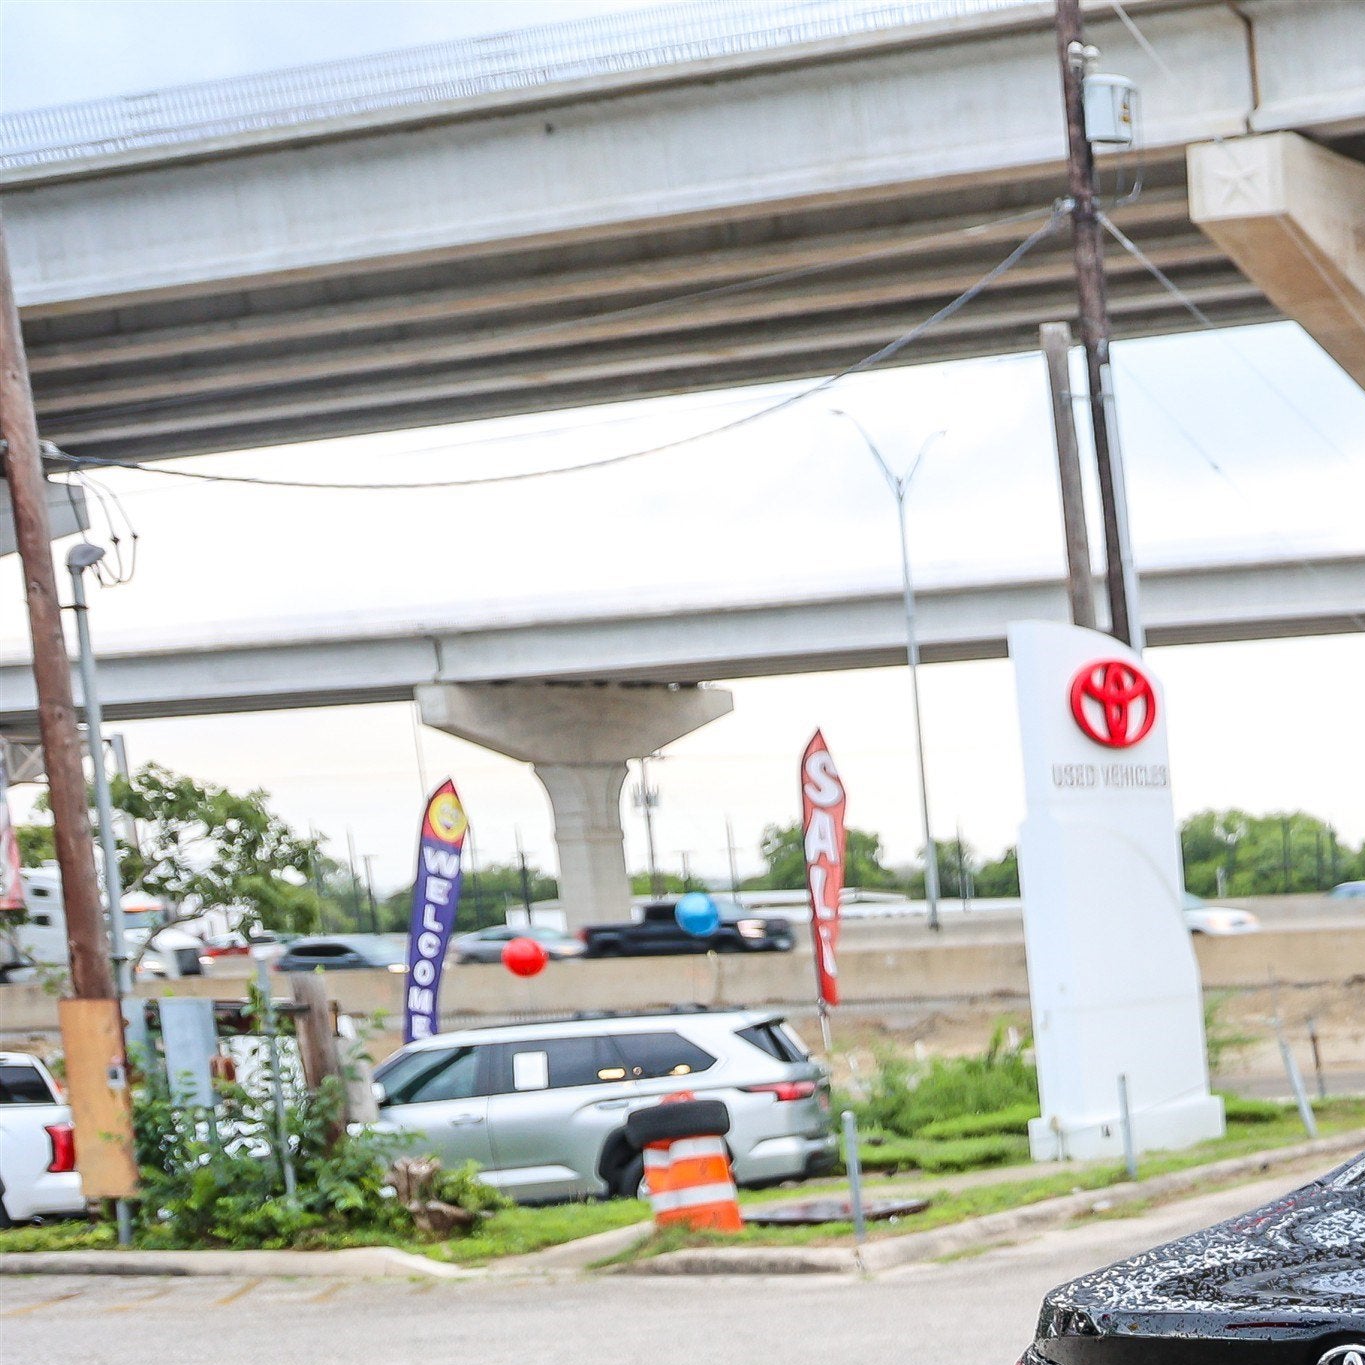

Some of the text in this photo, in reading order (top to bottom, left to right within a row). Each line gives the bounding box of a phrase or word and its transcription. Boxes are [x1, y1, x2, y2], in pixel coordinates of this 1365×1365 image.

[1052, 763, 1168, 788] USED VEHICLES
[407, 844, 461, 1040] WELCOME
